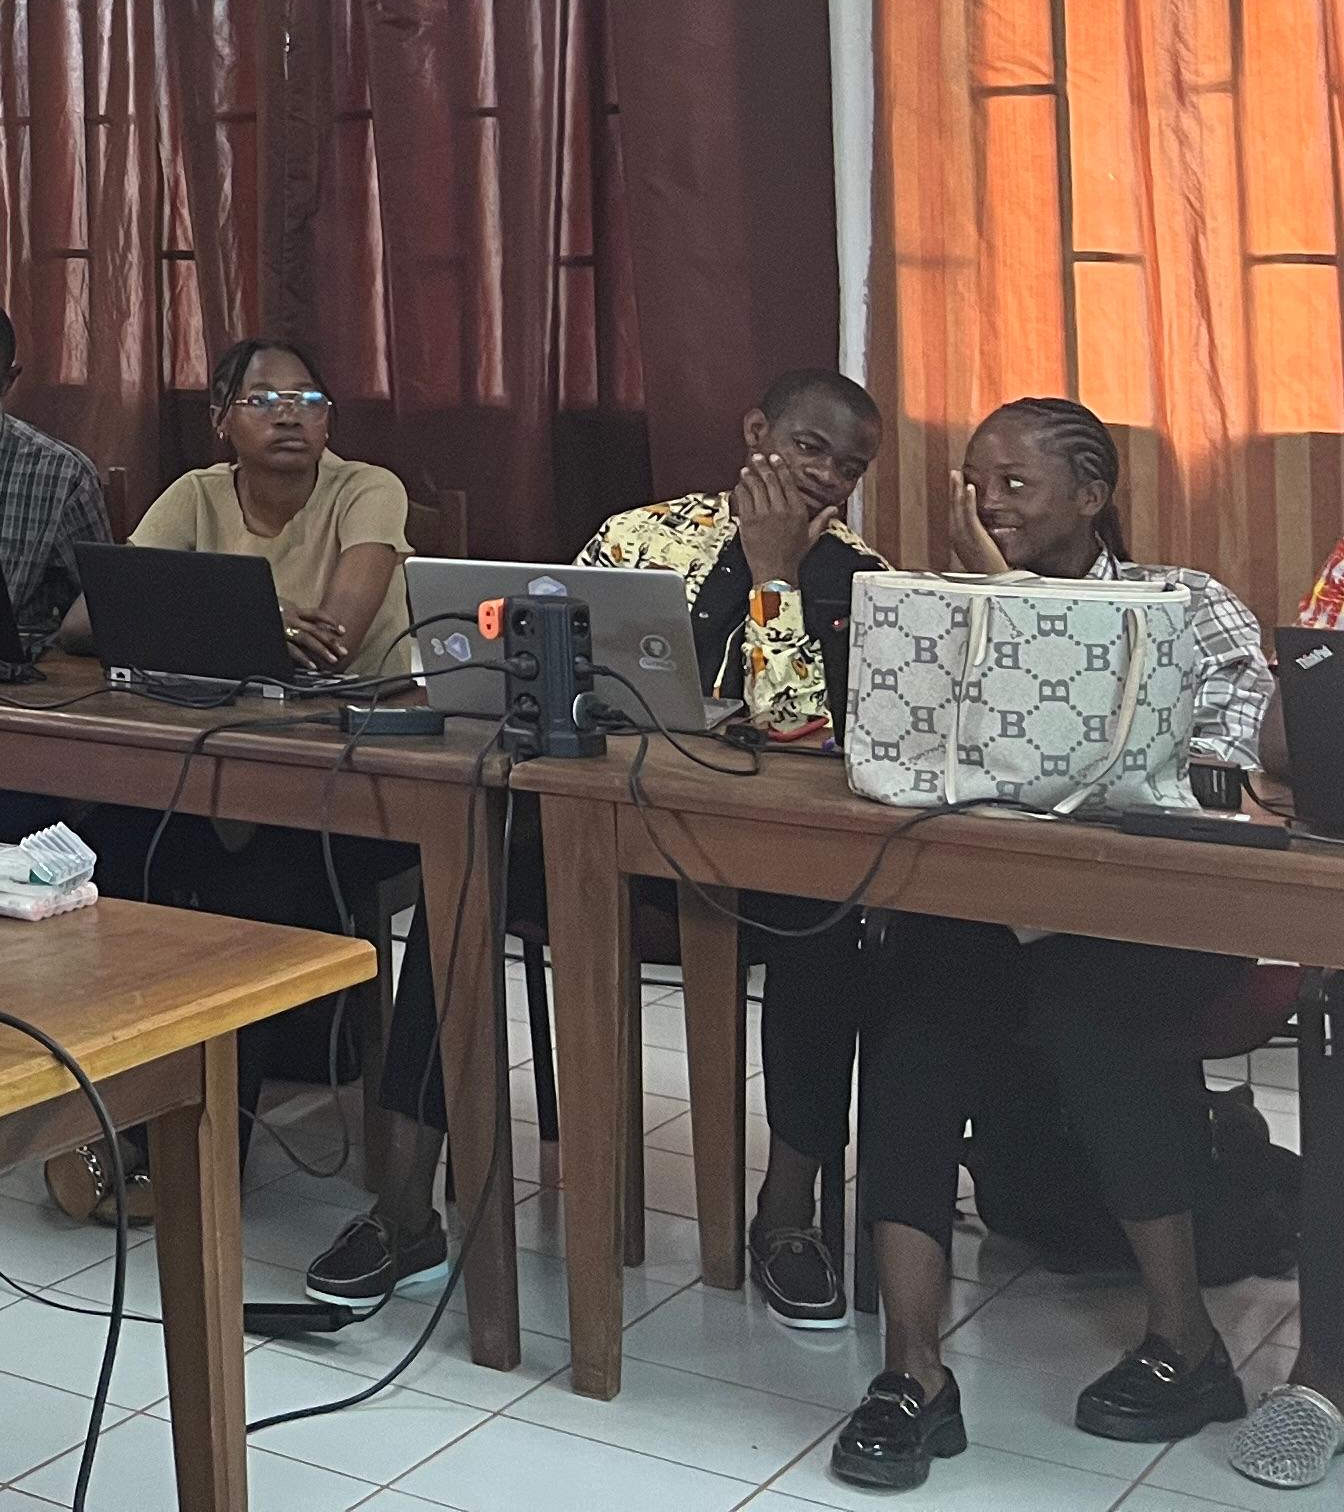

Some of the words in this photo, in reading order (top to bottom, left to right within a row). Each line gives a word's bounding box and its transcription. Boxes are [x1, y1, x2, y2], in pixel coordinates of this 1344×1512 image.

[873, 604, 898, 628] B
[1037, 612, 1068, 637] B
[912, 636, 939, 664] B
[994, 642, 1021, 669] B
[1085, 644, 1110, 671] B
[1157, 639, 1175, 667] B
[871, 668, 898, 693] B
[1039, 679, 1069, 705] B
[910, 706, 936, 734] B
[998, 710, 1026, 738] B
[1083, 715, 1109, 742] B
[1156, 707, 1171, 736] B
[871, 738, 900, 762] B
[958, 744, 984, 768] B
[1123, 748, 1147, 772] B
[1041, 752, 1070, 776] B
[912, 770, 939, 794] B
